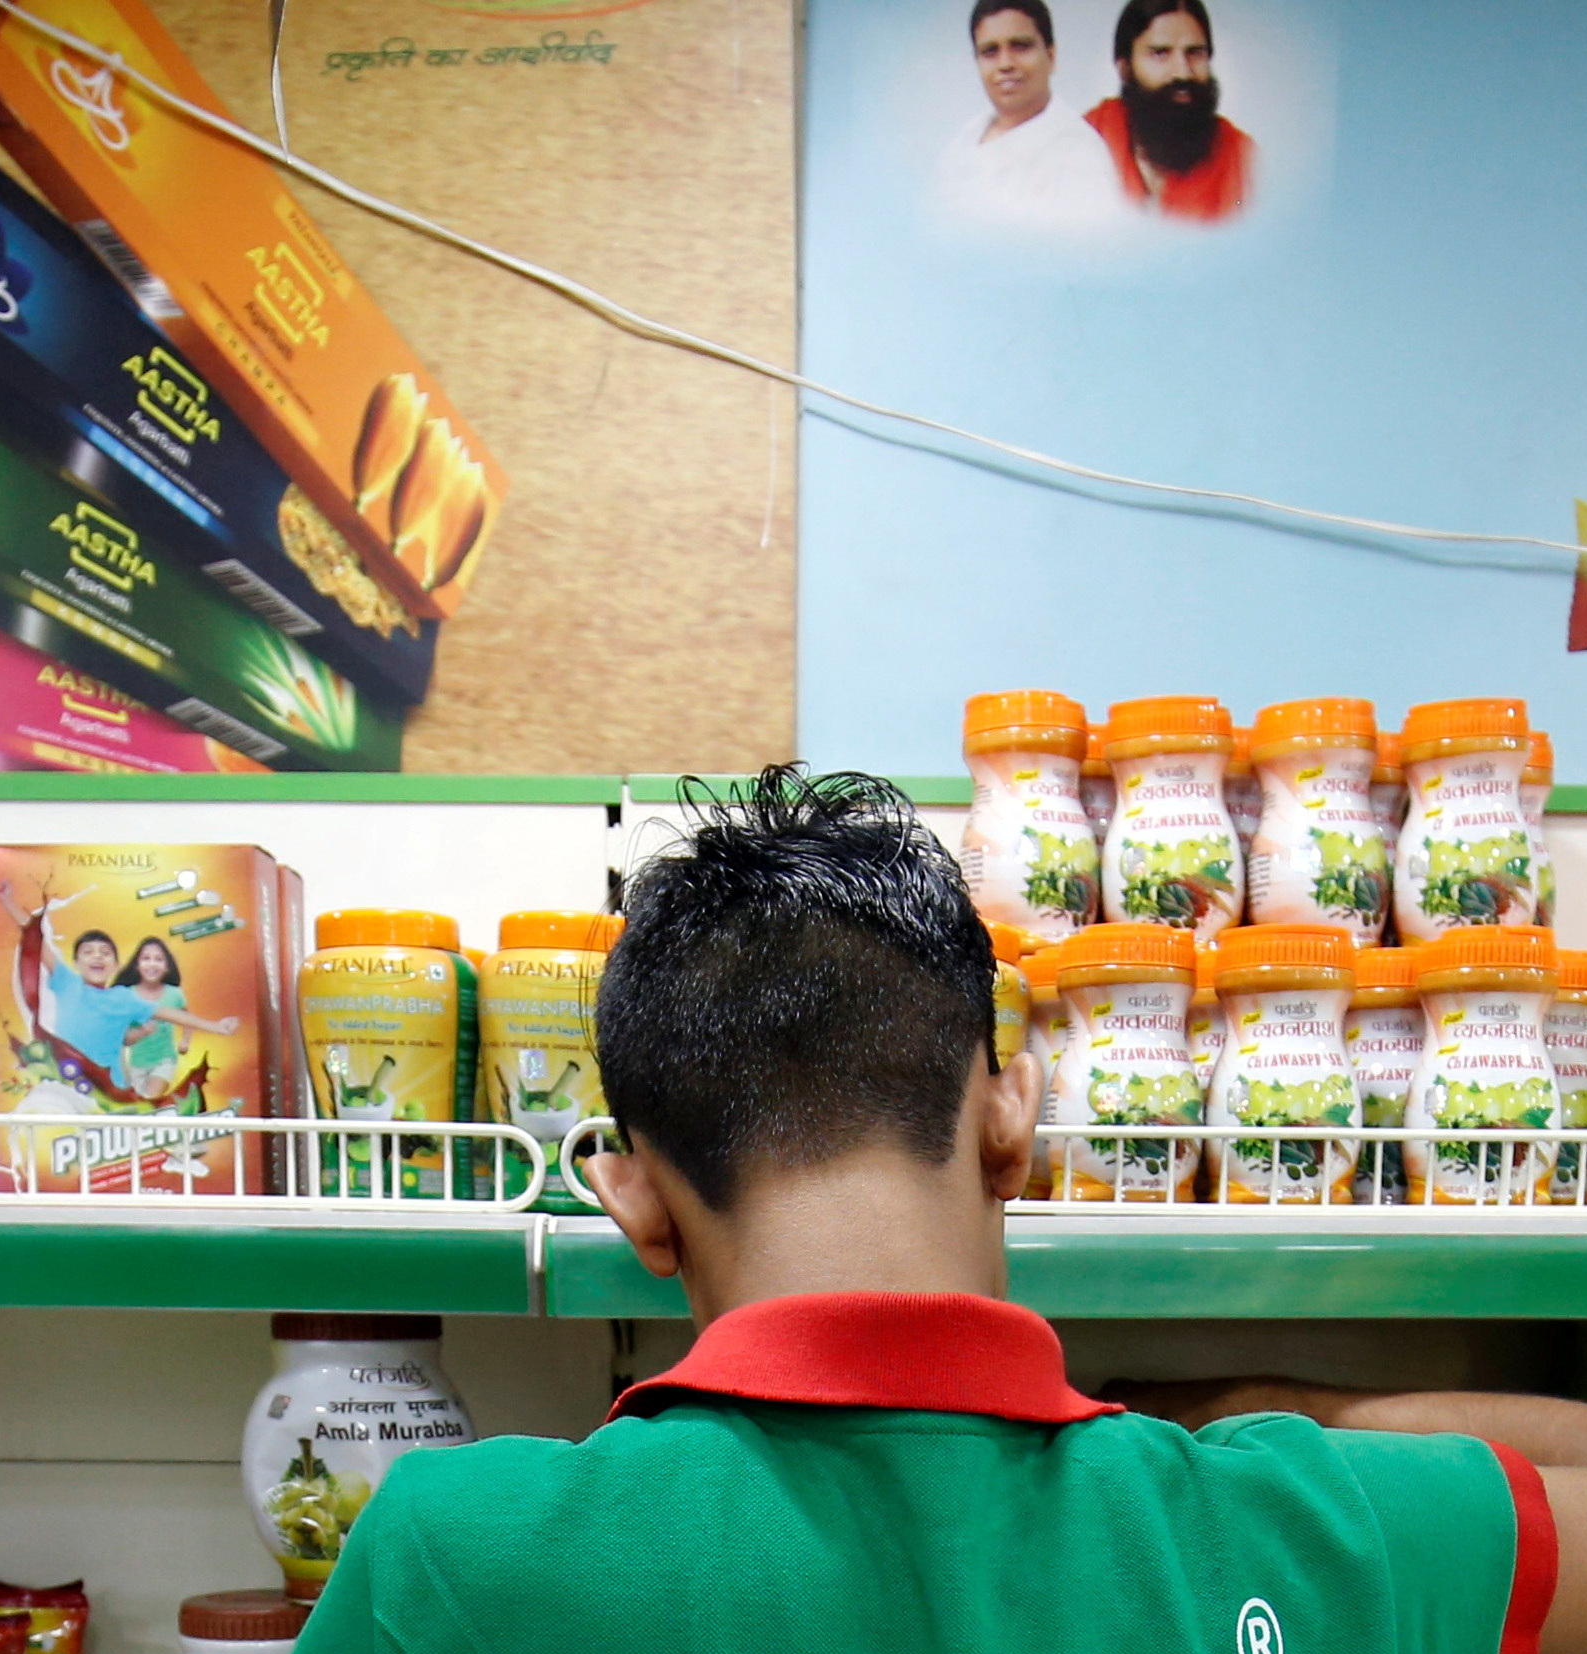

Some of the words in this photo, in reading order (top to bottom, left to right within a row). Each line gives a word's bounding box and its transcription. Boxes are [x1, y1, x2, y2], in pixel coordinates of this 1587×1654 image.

[245, 245, 331, 350] AASTHA
[120, 355, 220, 444] AASTHA
[48, 512, 158, 587] AASTHA
[67, 853, 155, 870] PATANJALI
[349, 1360, 430, 1389] पतंजलि
[327, 1396, 395, 1416] आंवला
[315, 1420, 370, 1441] Amla
[379, 1420, 464, 1441] Murabba
